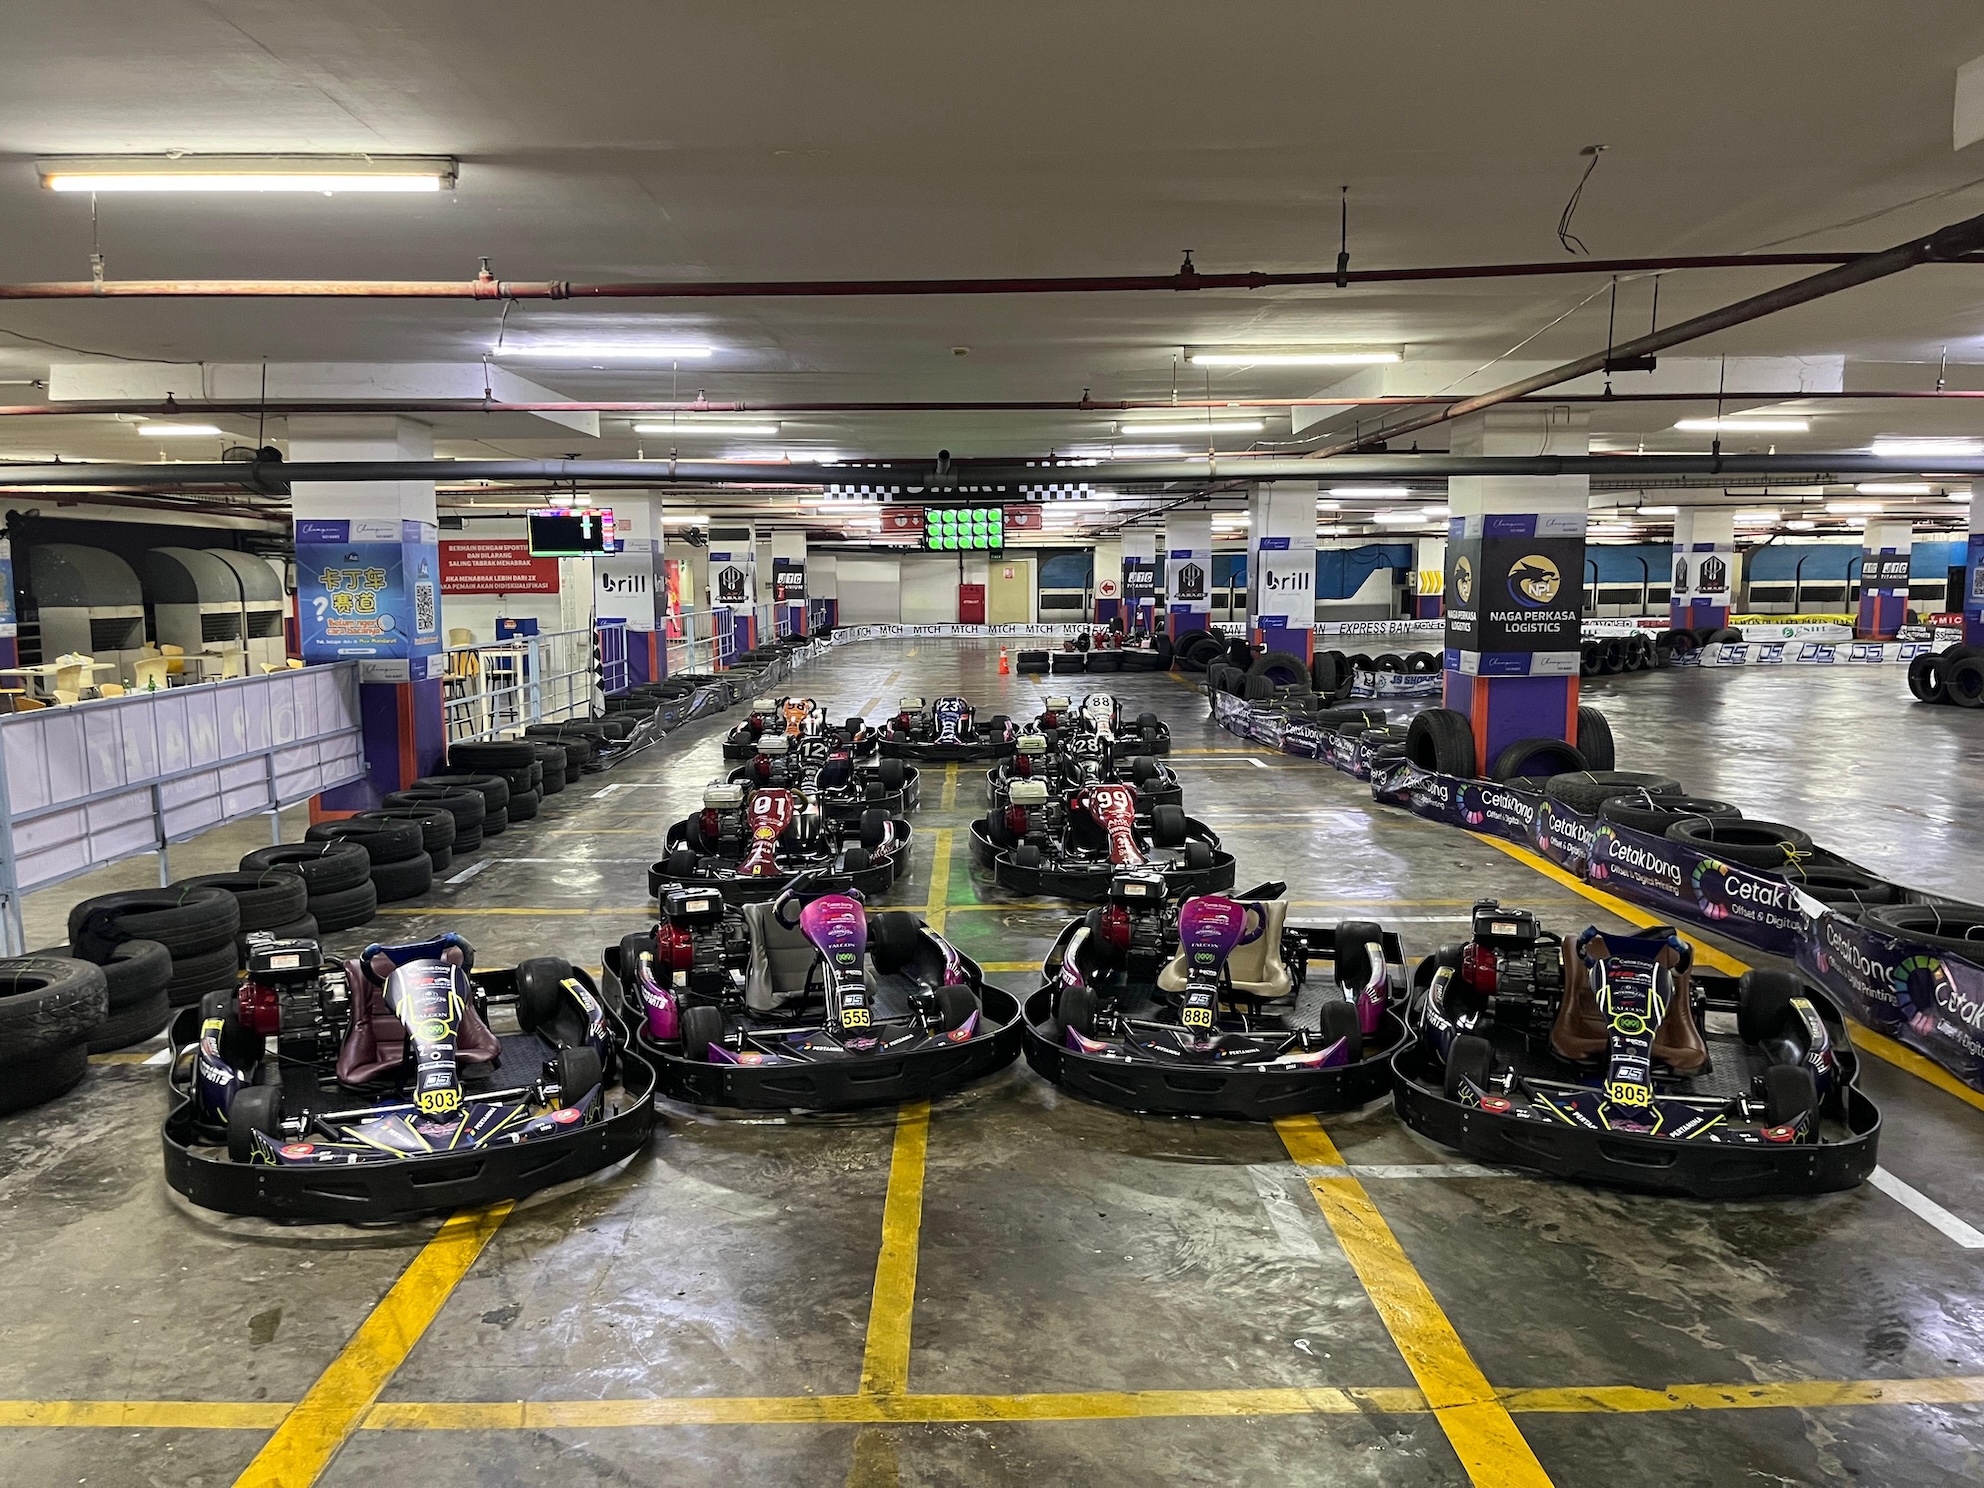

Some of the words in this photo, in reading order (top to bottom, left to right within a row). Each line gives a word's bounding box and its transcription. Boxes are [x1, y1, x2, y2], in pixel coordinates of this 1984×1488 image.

[319, 567, 387, 591] 卡丁车
[603, 573, 645, 592] brill
[1267, 570, 1309, 590] brill
[1528, 583, 1553, 597] NPL
[331, 591, 376, 615] 赛道
[327, 618, 354, 627] Belum
[1490, 611, 1524, 621] NAGA
[1524, 611, 1576, 621] PERKASA
[348, 627, 381, 636] bacanya
[880, 625, 903, 634] MTCH
[913, 625, 941, 634] MTCH
[952, 625, 978, 634] MTCH
[988, 625, 1016, 634] MTCH
[1025, 625, 1053, 634] MTCH
[1313, 624, 1326, 634] AN
[1339, 622, 1387, 634] EXPRESS
[1389, 622, 1411, 634] BAN
[1505, 622, 1561, 633] LOGISTICS
[941, 701, 959, 712] 23
[1093, 697, 1110, 707] 88
[802, 742, 826, 758] 12
[1075, 739, 1099, 754] 28
[754, 795, 785, 816] 01
[1097, 791, 1128, 809] 99
[1549, 814, 1578, 839] Cetak
[1609, 839, 1646, 868] Cetak
[1646, 852, 1682, 886] Dong
[1725, 876, 1784, 909] Cetak
[1731, 903, 1756, 920] Offset
[1756, 911, 1765, 921] &
[1766, 913, 1800, 931] Digita
[1826, 924, 1852, 965] Cetak
[843, 1011, 869, 1025] 555
[1184, 1010, 1210, 1024] 888
[889, 1033, 914, 1047] PERTAMINA
[1154, 1046, 1181, 1056] PERTAMINA
[1228, 1047, 1260, 1056] PERTAMINA
[424, 1092, 455, 1110] 303
[1614, 1085, 1645, 1103] 805
[475, 1106, 498, 1131] PERTAMINA
[1669, 1116, 1704, 1139] PERTAMINA
[387, 1128, 417, 1149] PERTAMINA
